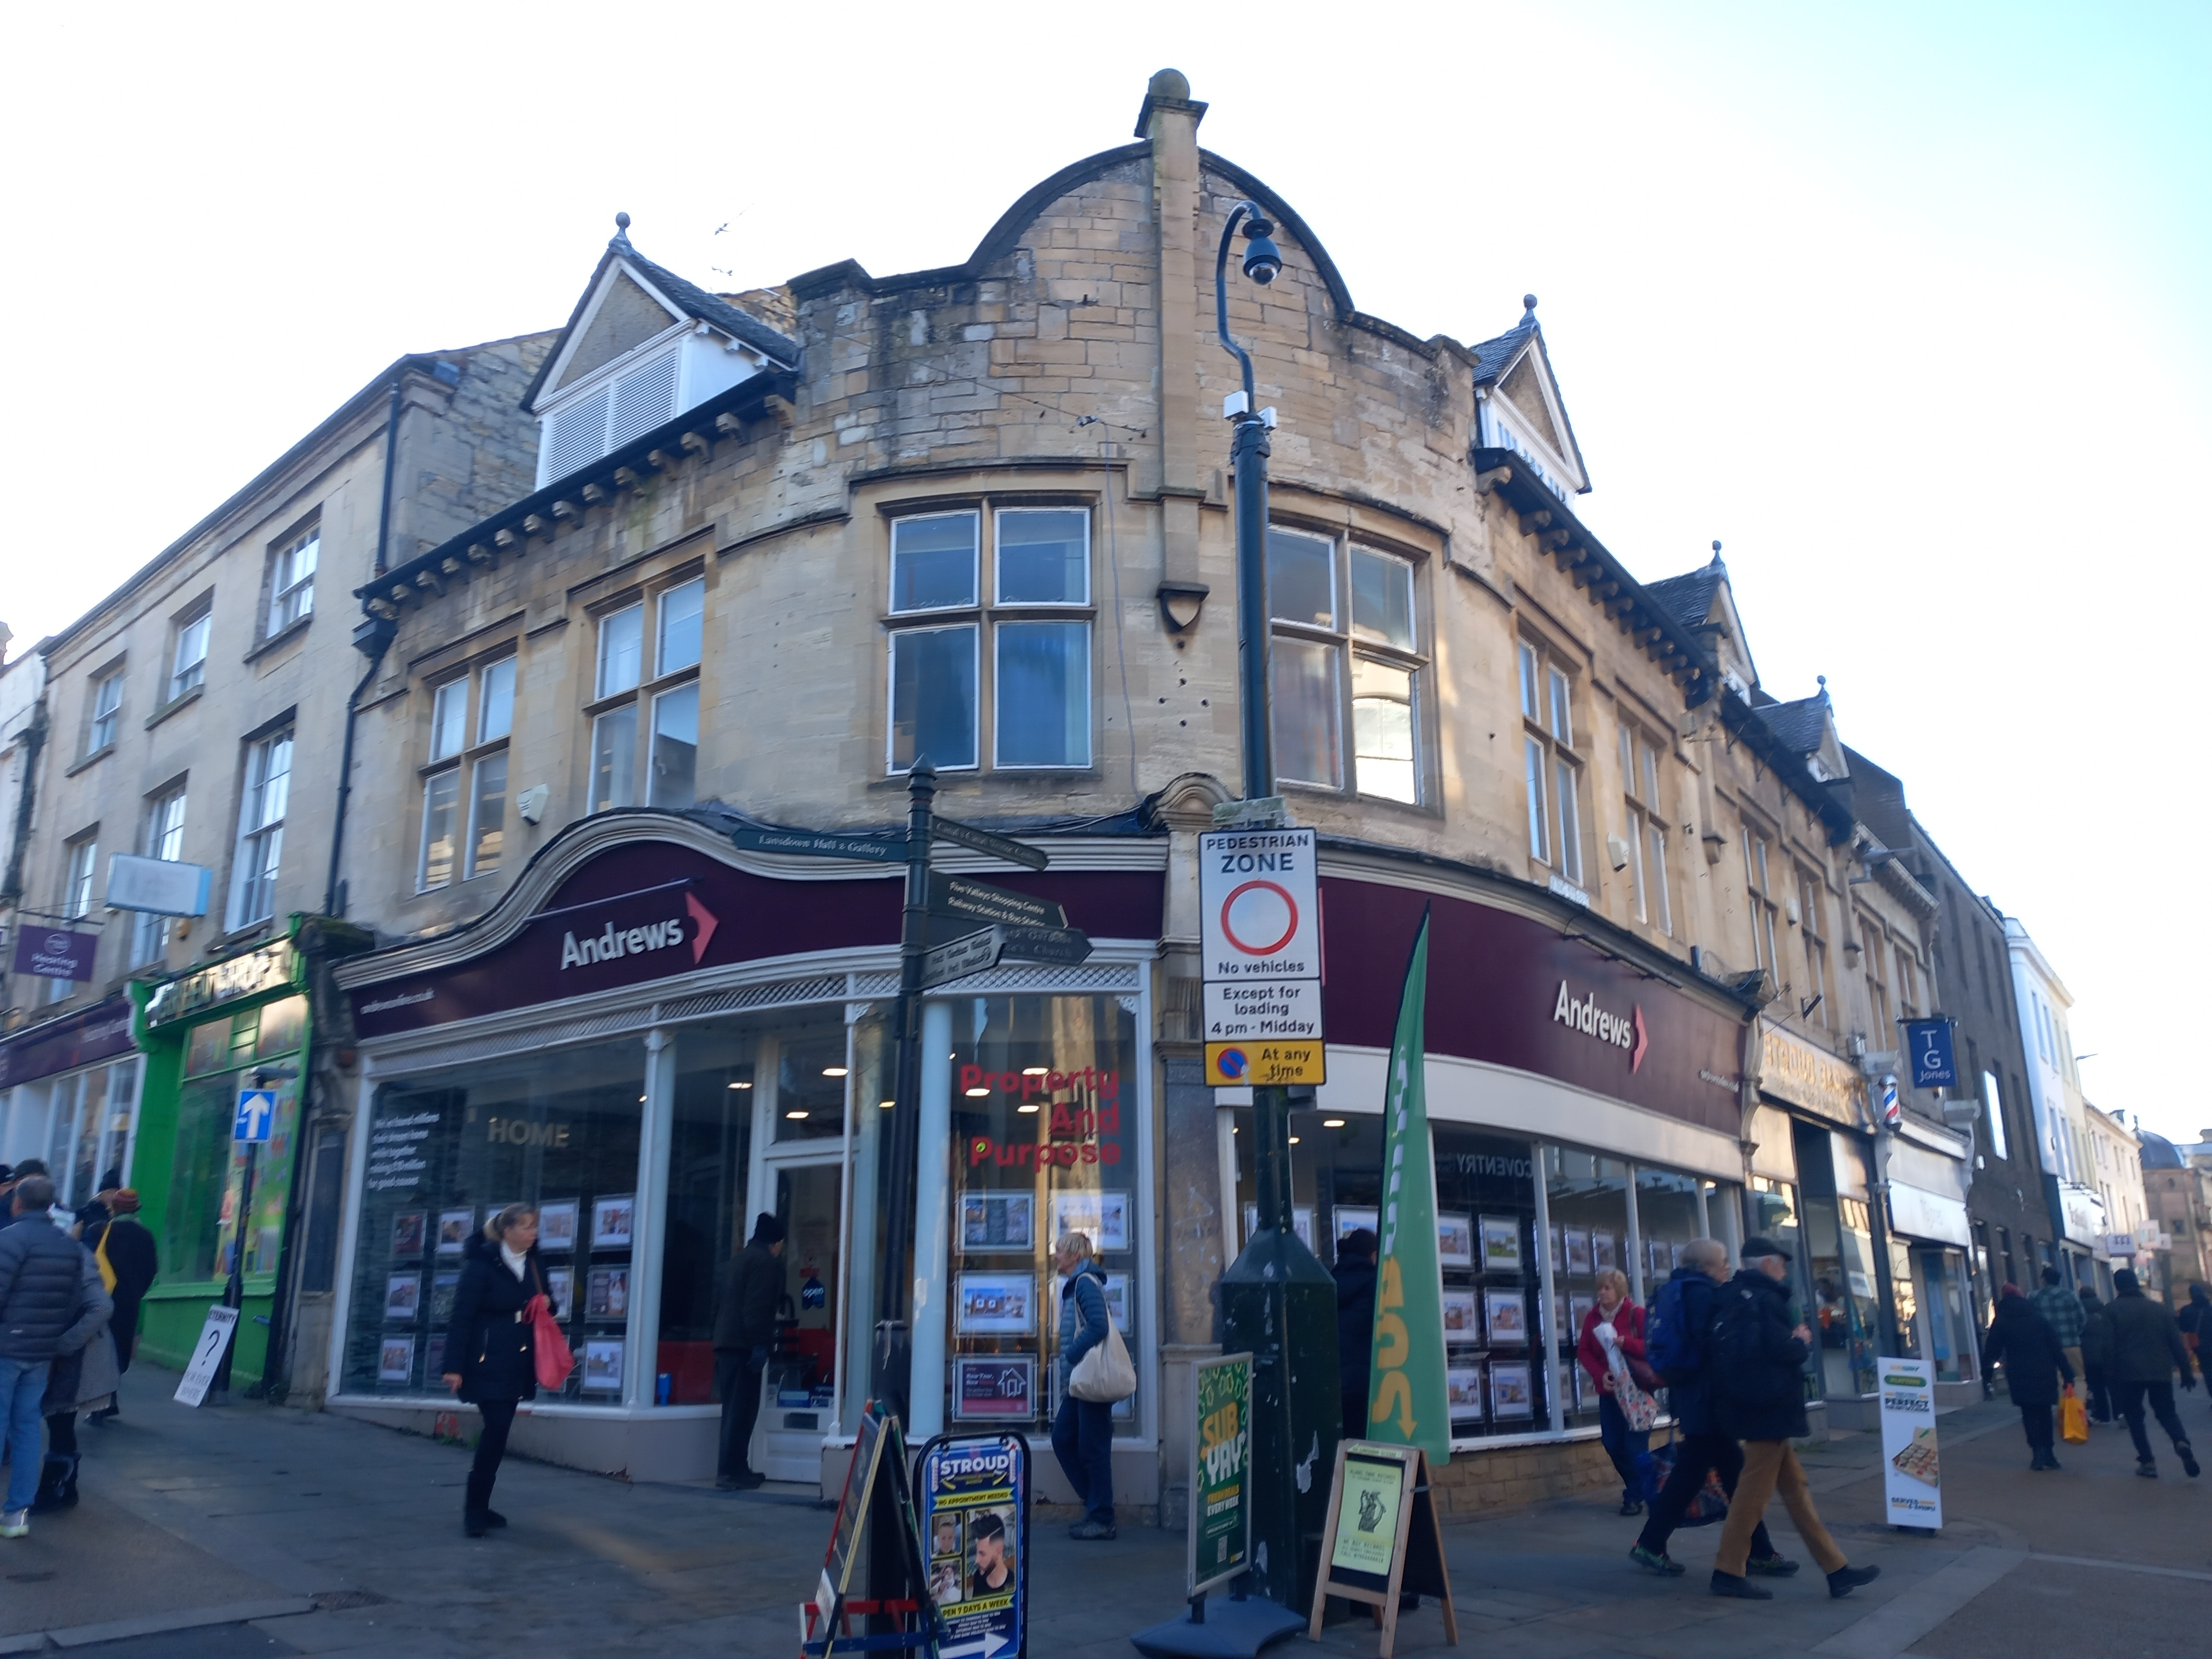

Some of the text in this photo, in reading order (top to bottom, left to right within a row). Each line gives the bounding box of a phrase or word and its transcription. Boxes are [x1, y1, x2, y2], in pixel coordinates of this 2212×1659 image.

[758, 835, 811, 848] Lansdown
[814, 838, 837, 850] Hall
[847, 841, 888, 857] Gallery
[1206, 833, 1309, 851] PEDESTRIAN
[1220, 852, 1294, 874] ZONE
[950, 880, 1046, 915] Five Valleys Shopping Centre
[948, 896, 976, 913] Railway
[976, 903, 1002, 918] Station
[1021, 915, 1046, 927] Station
[560, 918, 685, 970] Andrews
[1218, 960, 1304, 975] No vehicles
[1223, 985, 1301, 1002] Except for
[1234, 1001, 1289, 1017] loading
[1553, 979, 1631, 1049] Andrews
[1260, 1019, 1315, 1036] Midday
[1920, 1030, 1938, 1049] T
[1262, 1047, 1311, 1064] At any
[1924, 1049, 1941, 1070] G
[1270, 1063, 1303, 1077] time
[960, 1063, 1120, 1101] Property
[1048, 1102, 1120, 1131] And
[487, 1118, 570, 1148] HOME
[970, 1135, 1122, 1174] Purpose
[1200, 1401, 1239, 1462] SUB
[940, 1454, 1009, 1476] STROUD
[1207, 1429, 1246, 1487] YAY
[947, 1494, 986, 1505] APPOINTMENT
[987, 1491, 1009, 1500] NEEDED
[1207, 1501, 1225, 1517] EVERY
[942, 1598, 1009, 1617] PEN 7 DAYS A WEEK
